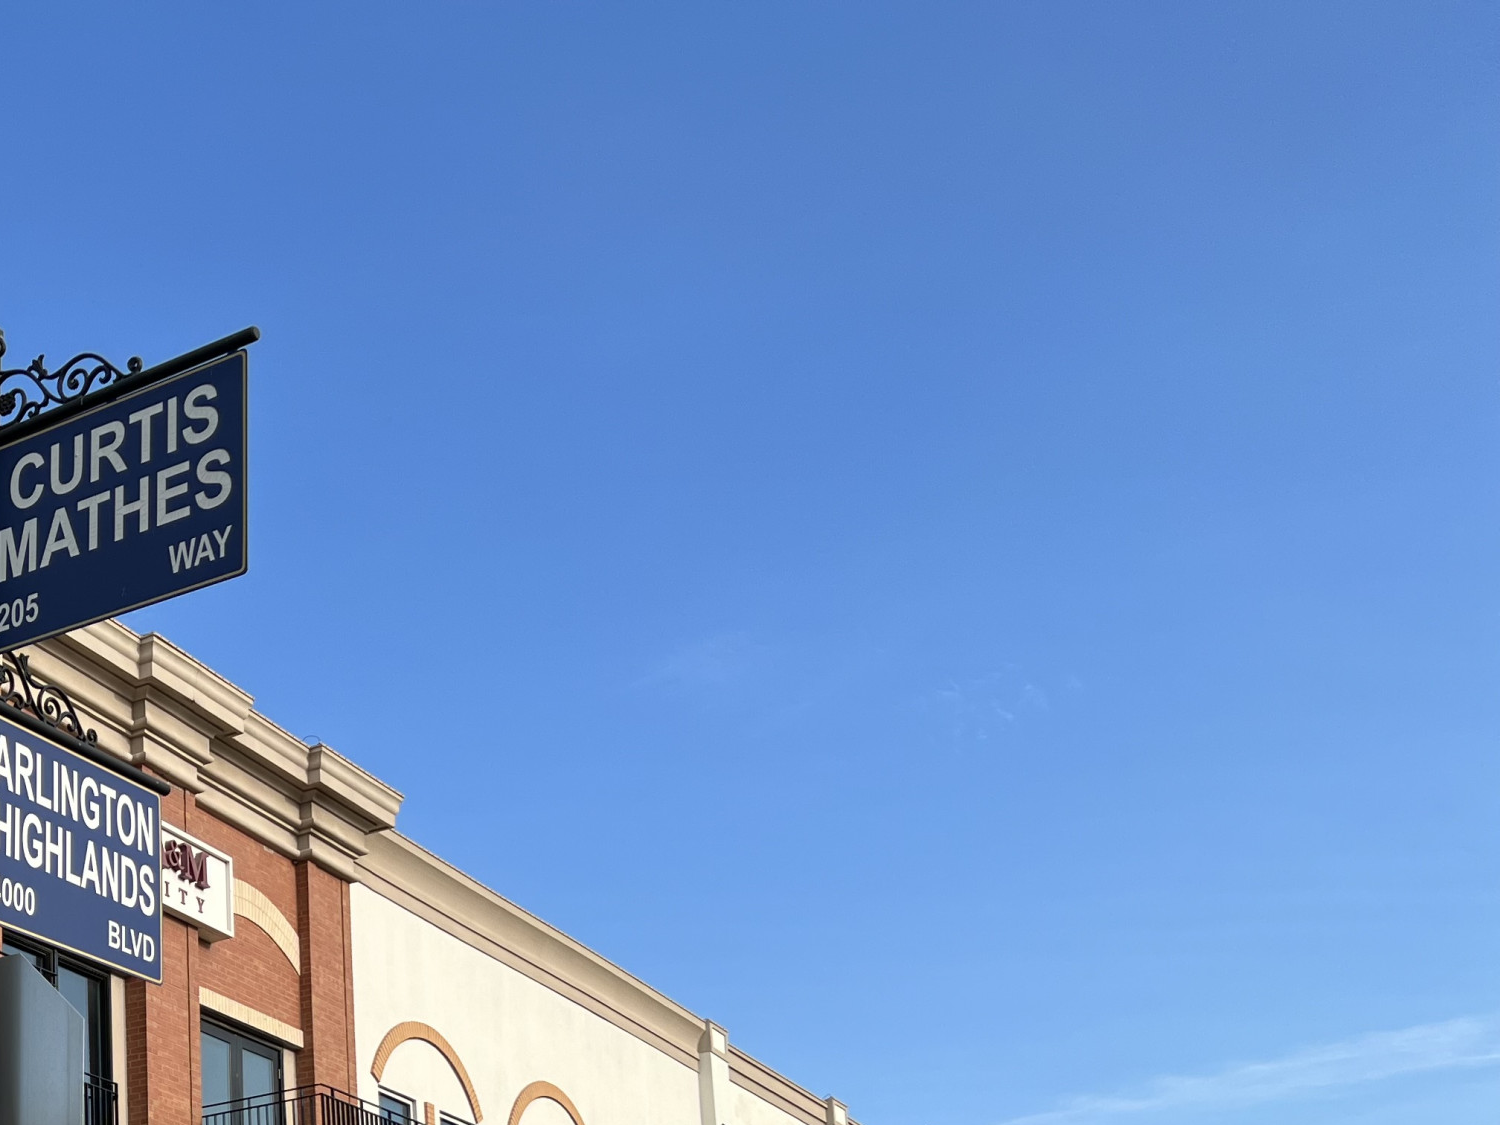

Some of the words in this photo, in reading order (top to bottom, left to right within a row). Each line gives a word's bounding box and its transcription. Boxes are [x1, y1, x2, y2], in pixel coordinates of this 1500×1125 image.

[10, 384, 219, 510] CURTIS
[168, 525, 233, 574] WAY
[108, 919, 155, 962] BLVD
